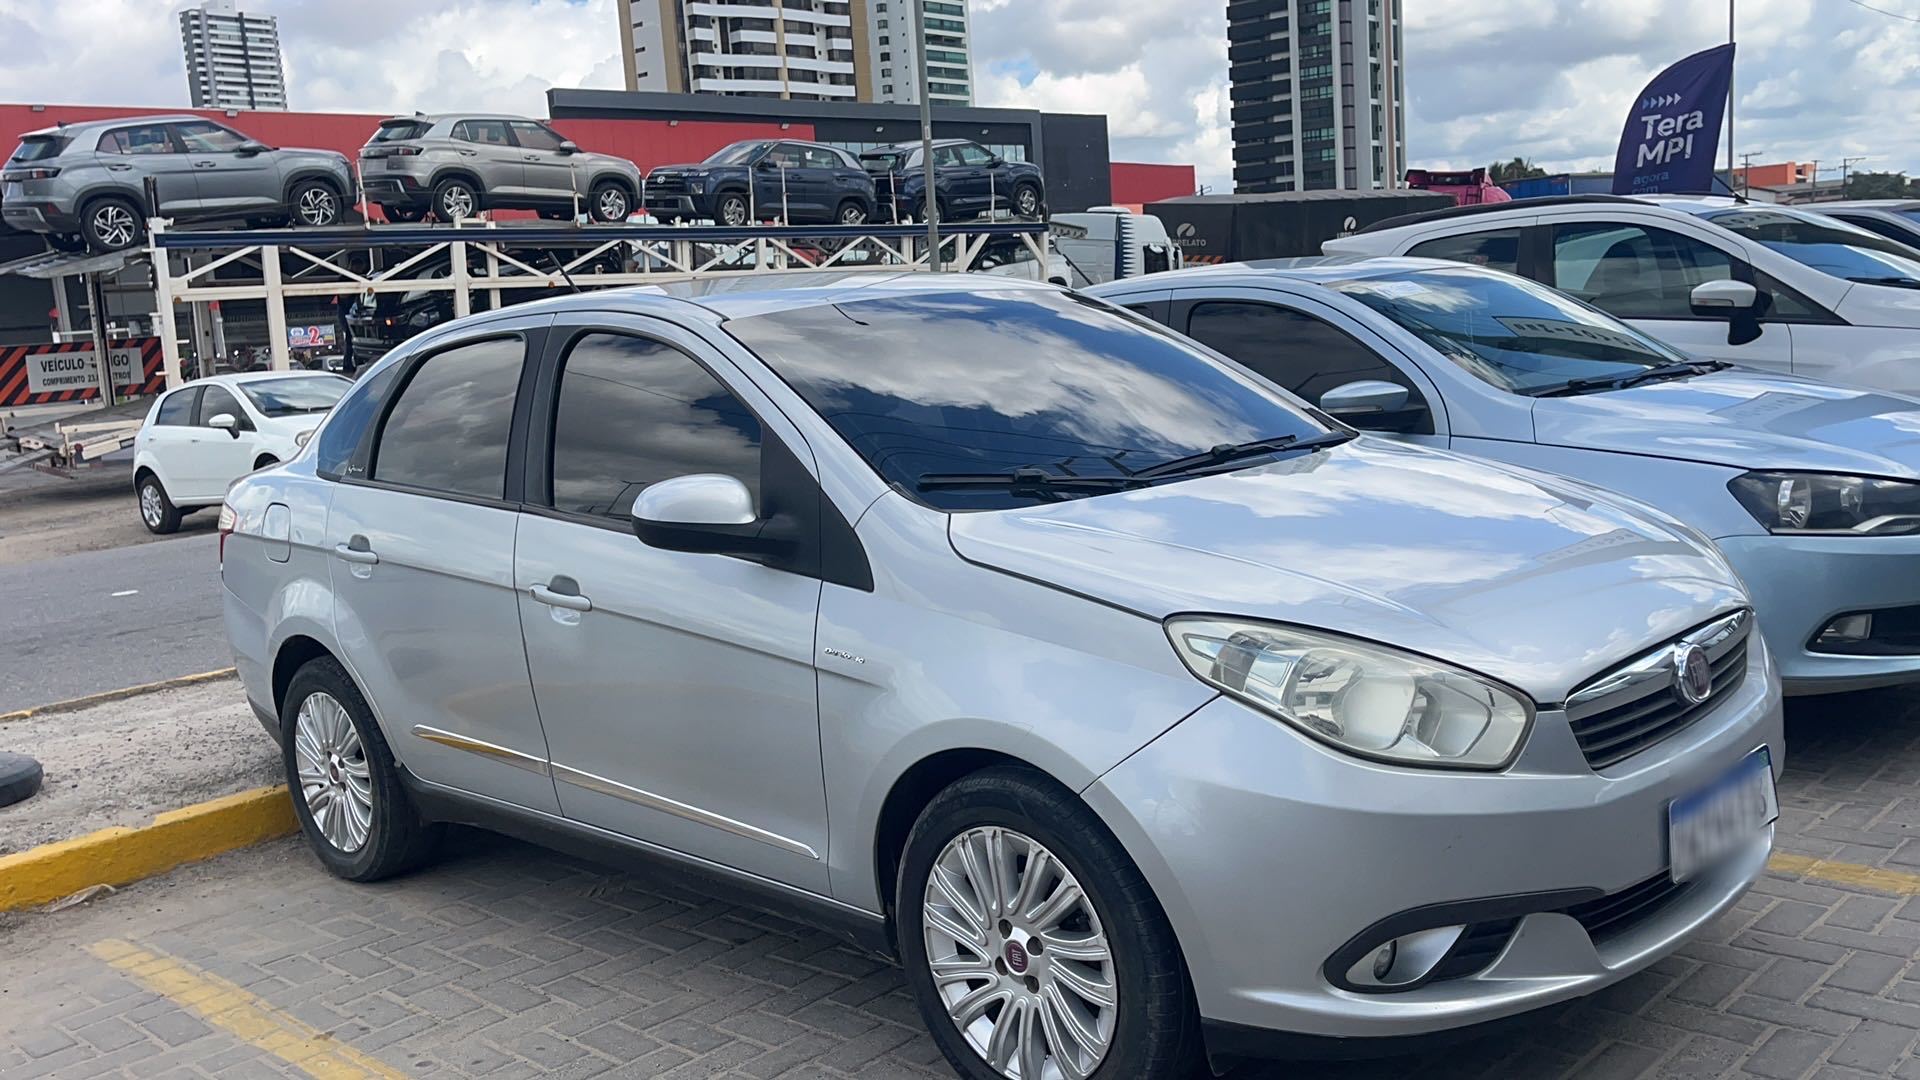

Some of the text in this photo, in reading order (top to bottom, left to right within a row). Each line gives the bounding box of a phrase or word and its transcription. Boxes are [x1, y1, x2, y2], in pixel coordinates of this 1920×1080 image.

[1641, 110, 1703, 139] Tera
[1636, 133, 1694, 168] MPI
[1633, 171, 1669, 186] agora
[41, 357, 85, 372] VEÍCULO
[42, 375, 85, 386] COMPRIMENTO
